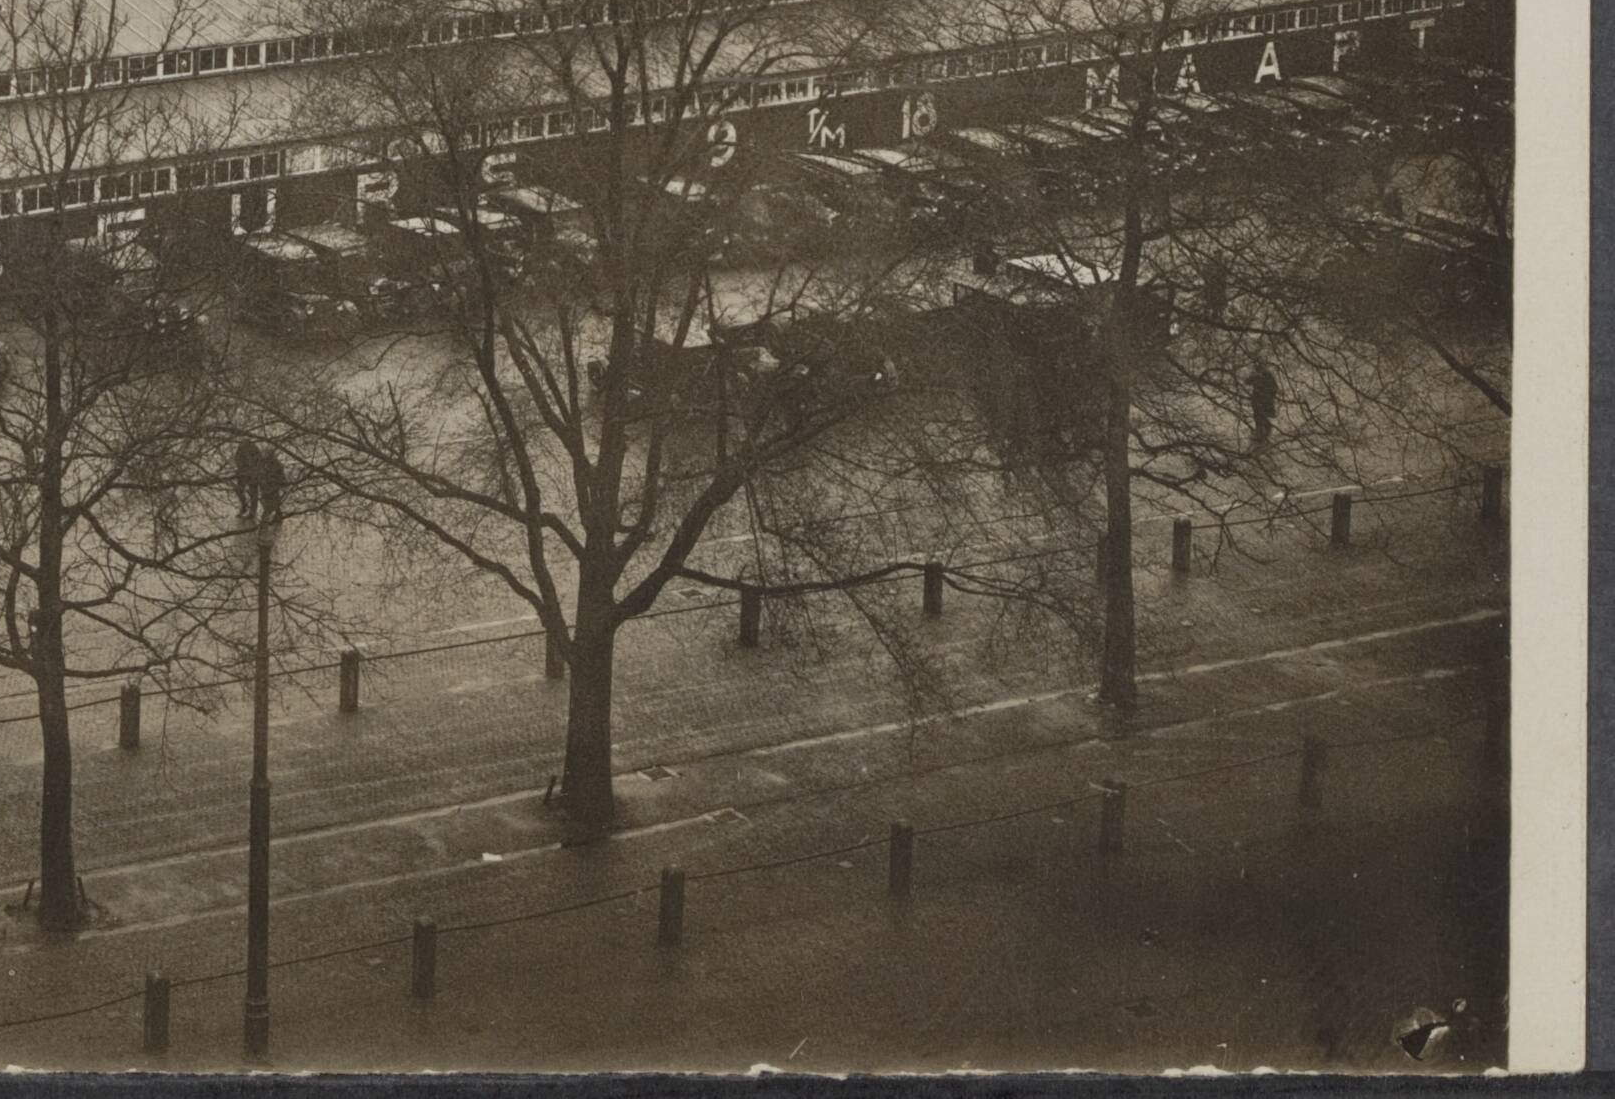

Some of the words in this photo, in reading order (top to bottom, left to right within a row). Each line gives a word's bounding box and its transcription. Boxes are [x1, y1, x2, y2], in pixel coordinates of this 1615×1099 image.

[707, 121, 736, 168] 9
[807, 106, 846, 149] T/M
[902, 91, 938, 140] 18
